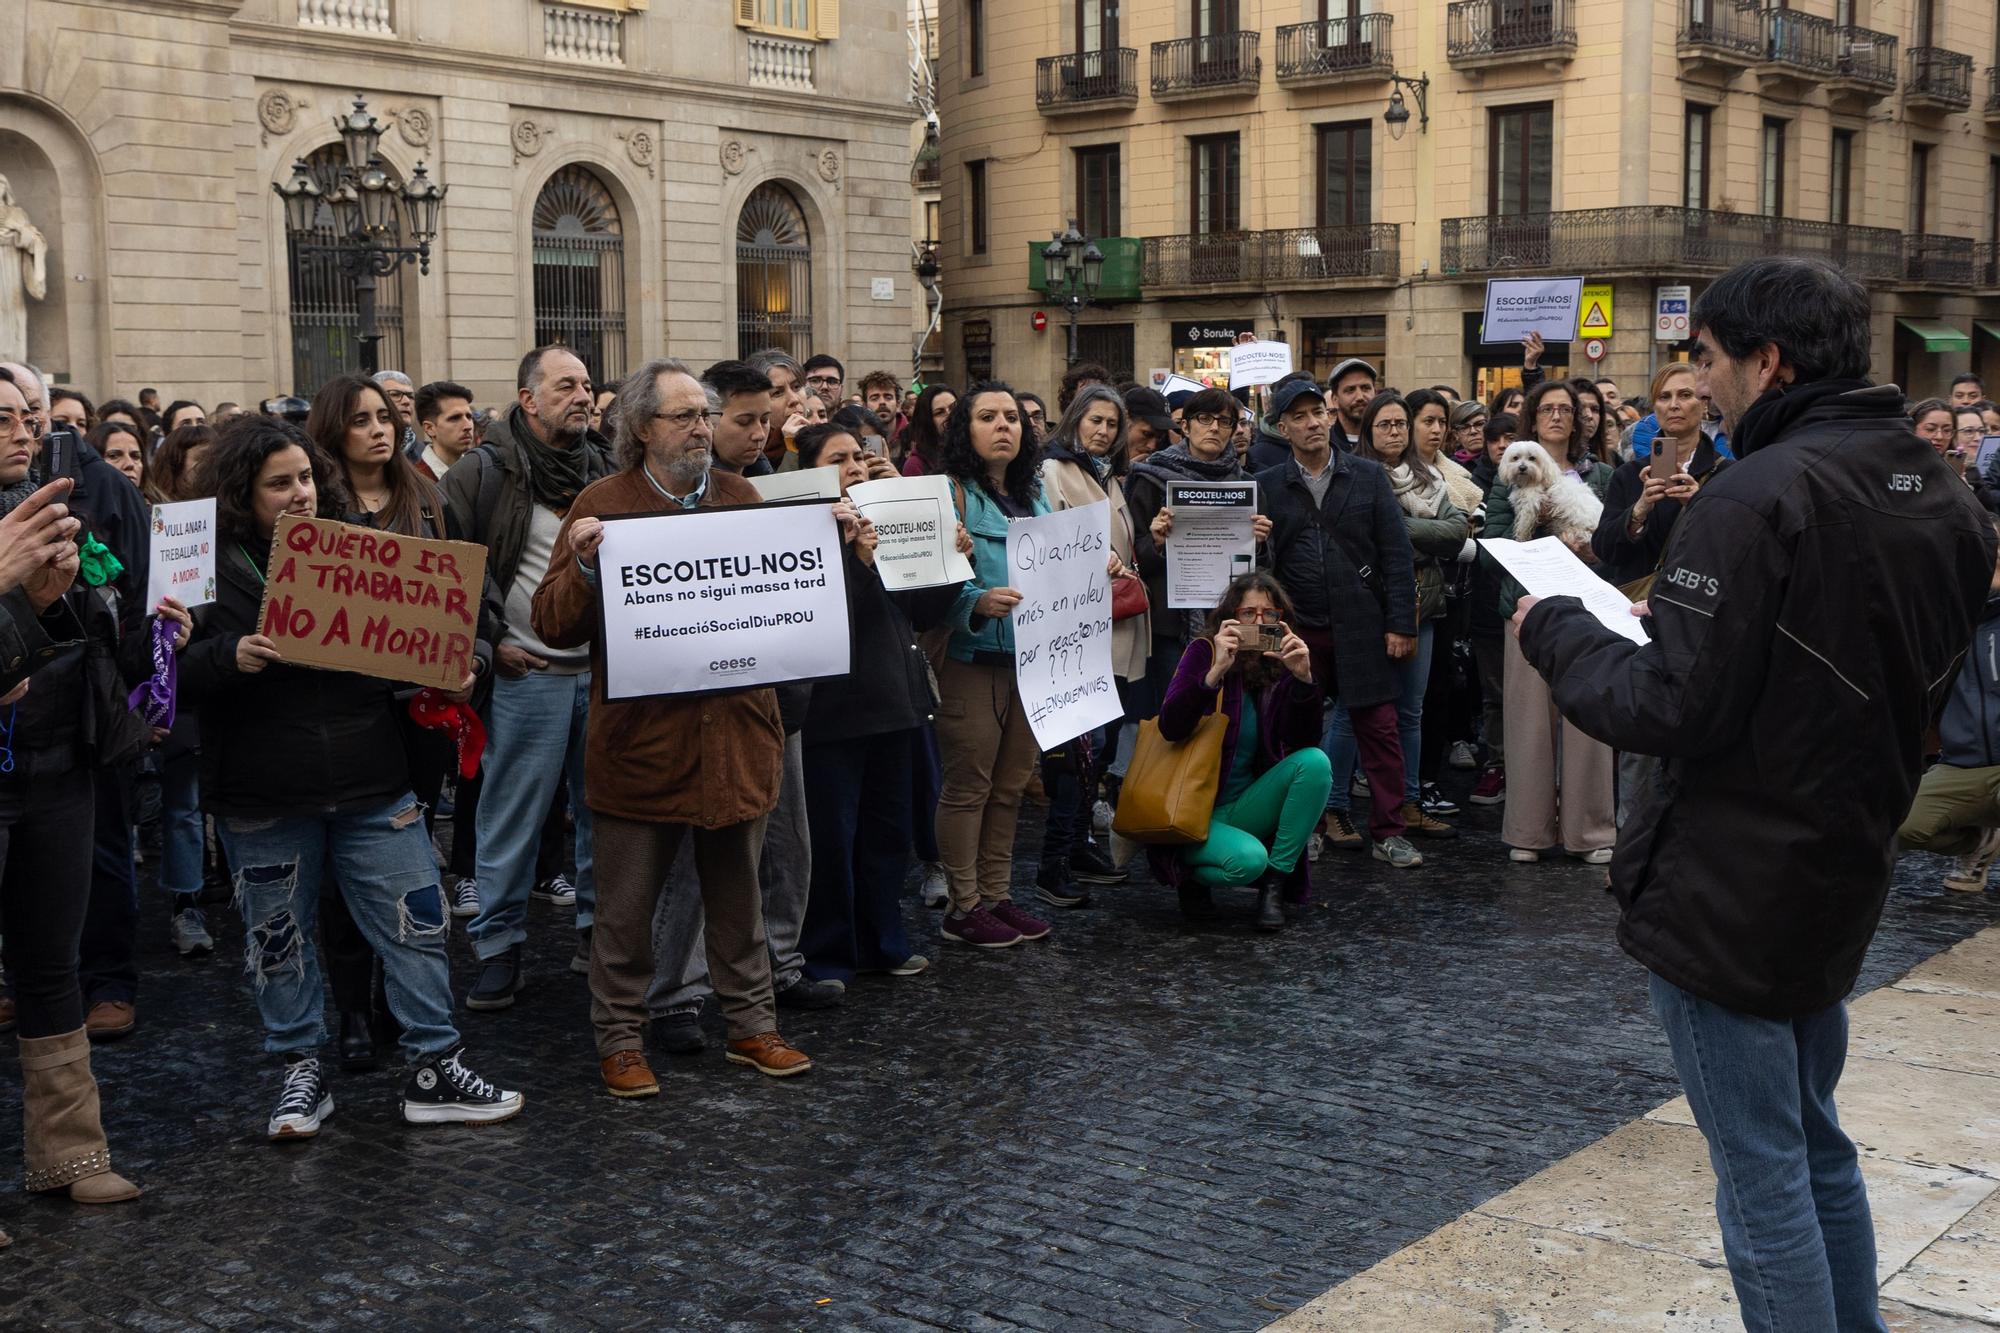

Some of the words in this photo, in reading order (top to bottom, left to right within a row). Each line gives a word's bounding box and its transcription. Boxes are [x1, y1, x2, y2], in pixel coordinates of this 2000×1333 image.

[1496, 294, 1572, 305] ESCOLTEU-NOS!
[1203, 328, 1235, 338] Soruka
[1178, 490, 1246, 500] ESCOLTEU-NOS!
[1888, 473, 1922, 493] JEB'S
[164, 523, 184, 537] VULL
[184, 520, 202, 535] ANAR
[202, 519, 207, 531] A
[898, 535, 909, 545] sigui
[160, 544, 200, 562] TREBALLAR,
[200, 542, 209, 557] NO
[1016, 524, 1103, 572] Quantes
[172, 571, 178, 585] A
[413, 549, 462, 584] IR
[621, 547, 824, 587] ESCOLTEU-NOS!
[275, 556, 296, 584] A
[306, 563, 473, 626] TRABAJAR
[624, 590, 673, 606] Abans
[678, 590, 696, 600] no
[700, 583, 736, 601] sigui
[741, 581, 790, 595] massa
[794, 573, 826, 590] tard
[1667, 567, 1719, 596] JEB'S
[1017, 600, 1044, 627] més
[1052, 596, 1068, 612] en
[1073, 571, 1104, 611] voleu
[263, 594, 316, 639] NO
[320, 606, 350, 647] A
[361, 614, 472, 680] MORIR
[634, 610, 814, 640] #EducacióSocialDiuPROU
[1019, 643, 1040, 678] per
[1049, 616, 1112, 652] reaccionar
[709, 656, 756, 671] ceesc
